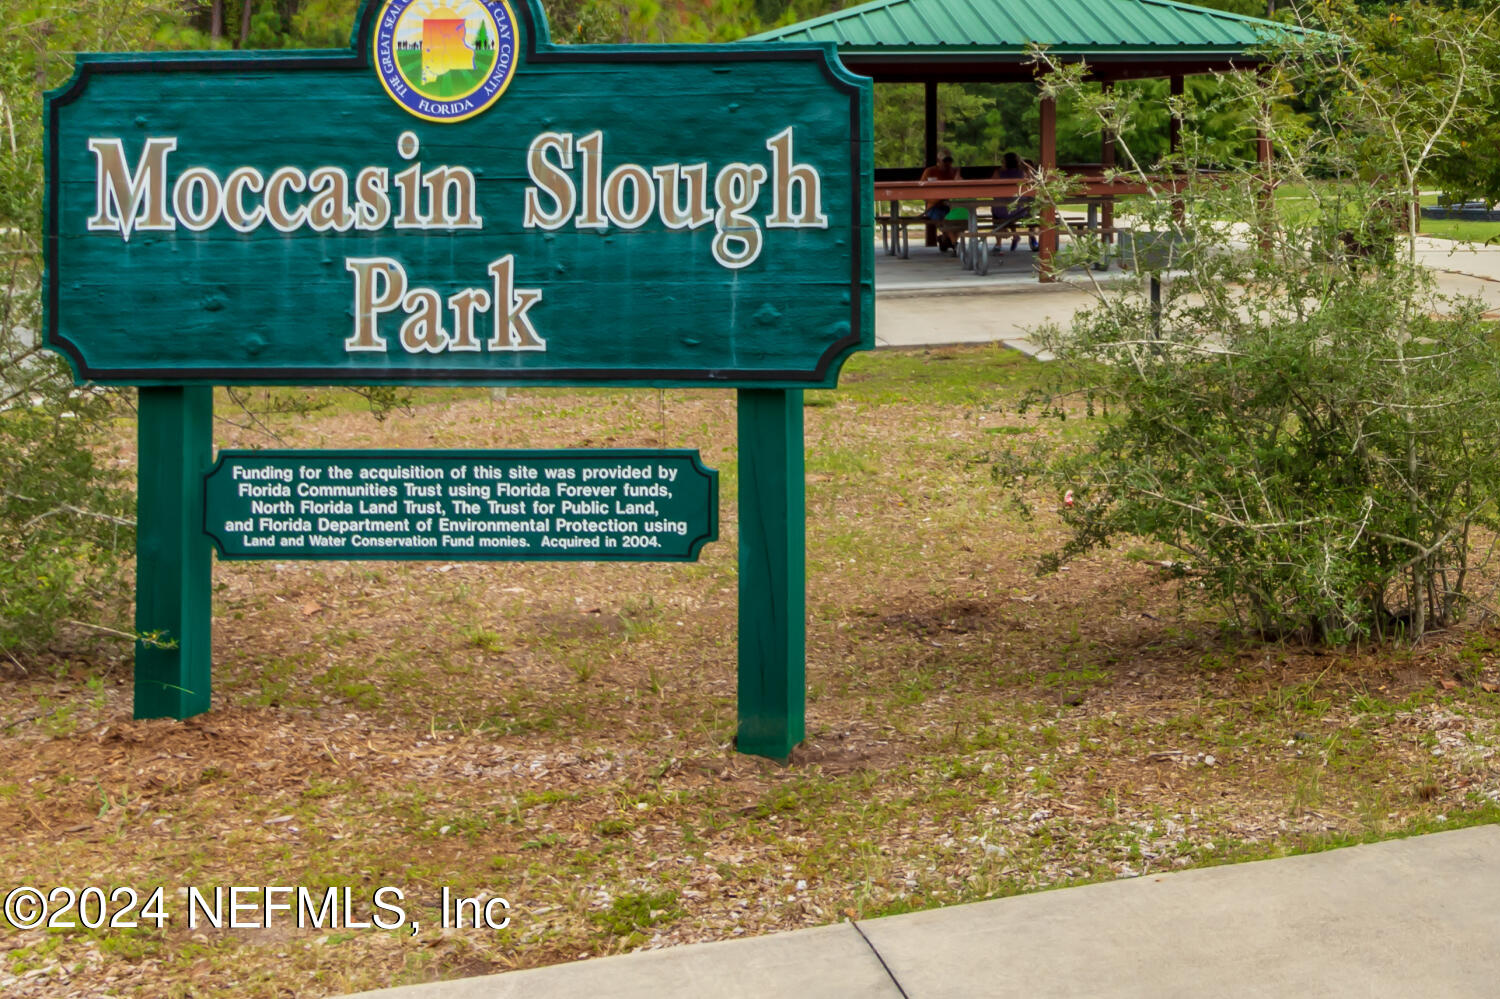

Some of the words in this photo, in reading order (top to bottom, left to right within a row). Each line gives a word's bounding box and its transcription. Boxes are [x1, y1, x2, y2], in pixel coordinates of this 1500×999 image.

[493, 8, 511, 40] CLAY
[380, 32, 394, 74] GREAT
[484, 43, 511, 96] COUNTY
[389, 75, 408, 97] THE
[418, 99, 475, 115] FLORIDA
[87, 130, 483, 243] Moccasin
[523, 126, 829, 270] Slough
[344, 253, 547, 354] Park
[232, 465, 294, 482] Funding
[298, 465, 322, 479] for
[327, 465, 354, 479] the
[359, 465, 444, 482] acquisition
[450, 465, 467, 479] of
[473, 465, 503, 479] this
[508, 465, 538, 479] site
[544, 469, 576, 479] was
[582, 465, 652, 482] provided
[658, 465, 678, 482] by
[238, 482, 291, 497] Florida
[296, 482, 398, 497] Communities
[403, 482, 443, 497] Trust
[448, 482, 491, 500] using
[496, 482, 551, 497] Florida
[556, 482, 617, 497] Forever
[623, 482, 673, 500] funds,
[251, 500, 295, 515] North
[300, 500, 354, 515] Florida
[359, 500, 398, 515] Land
[402, 500, 446, 517] Trust,
[451, 500, 481, 515] The
[486, 500, 527, 515] Trust
[532, 500, 556, 515] for
[561, 500, 609, 515] Public
[615, 500, 659, 517] Land,
[224, 518, 254, 533] and
[259, 518, 312, 533] Florida
[317, 518, 410, 535] Department
[415, 518, 433, 533] of
[438, 518, 550, 533] Environmental
[555, 518, 638, 533] Protection
[644, 518, 688, 535] using
[243, 535, 276, 547] Land
[279, 535, 305, 547] and
[308, 535, 347, 547] Water
[350, 535, 438, 547] Conservation
[441, 535, 475, 547] Fund
[478, 535, 531, 547] monies.
[540, 535, 600, 550] Acquired
[604, 535, 617, 547] in
[622, 535, 662, 547] 2004.
